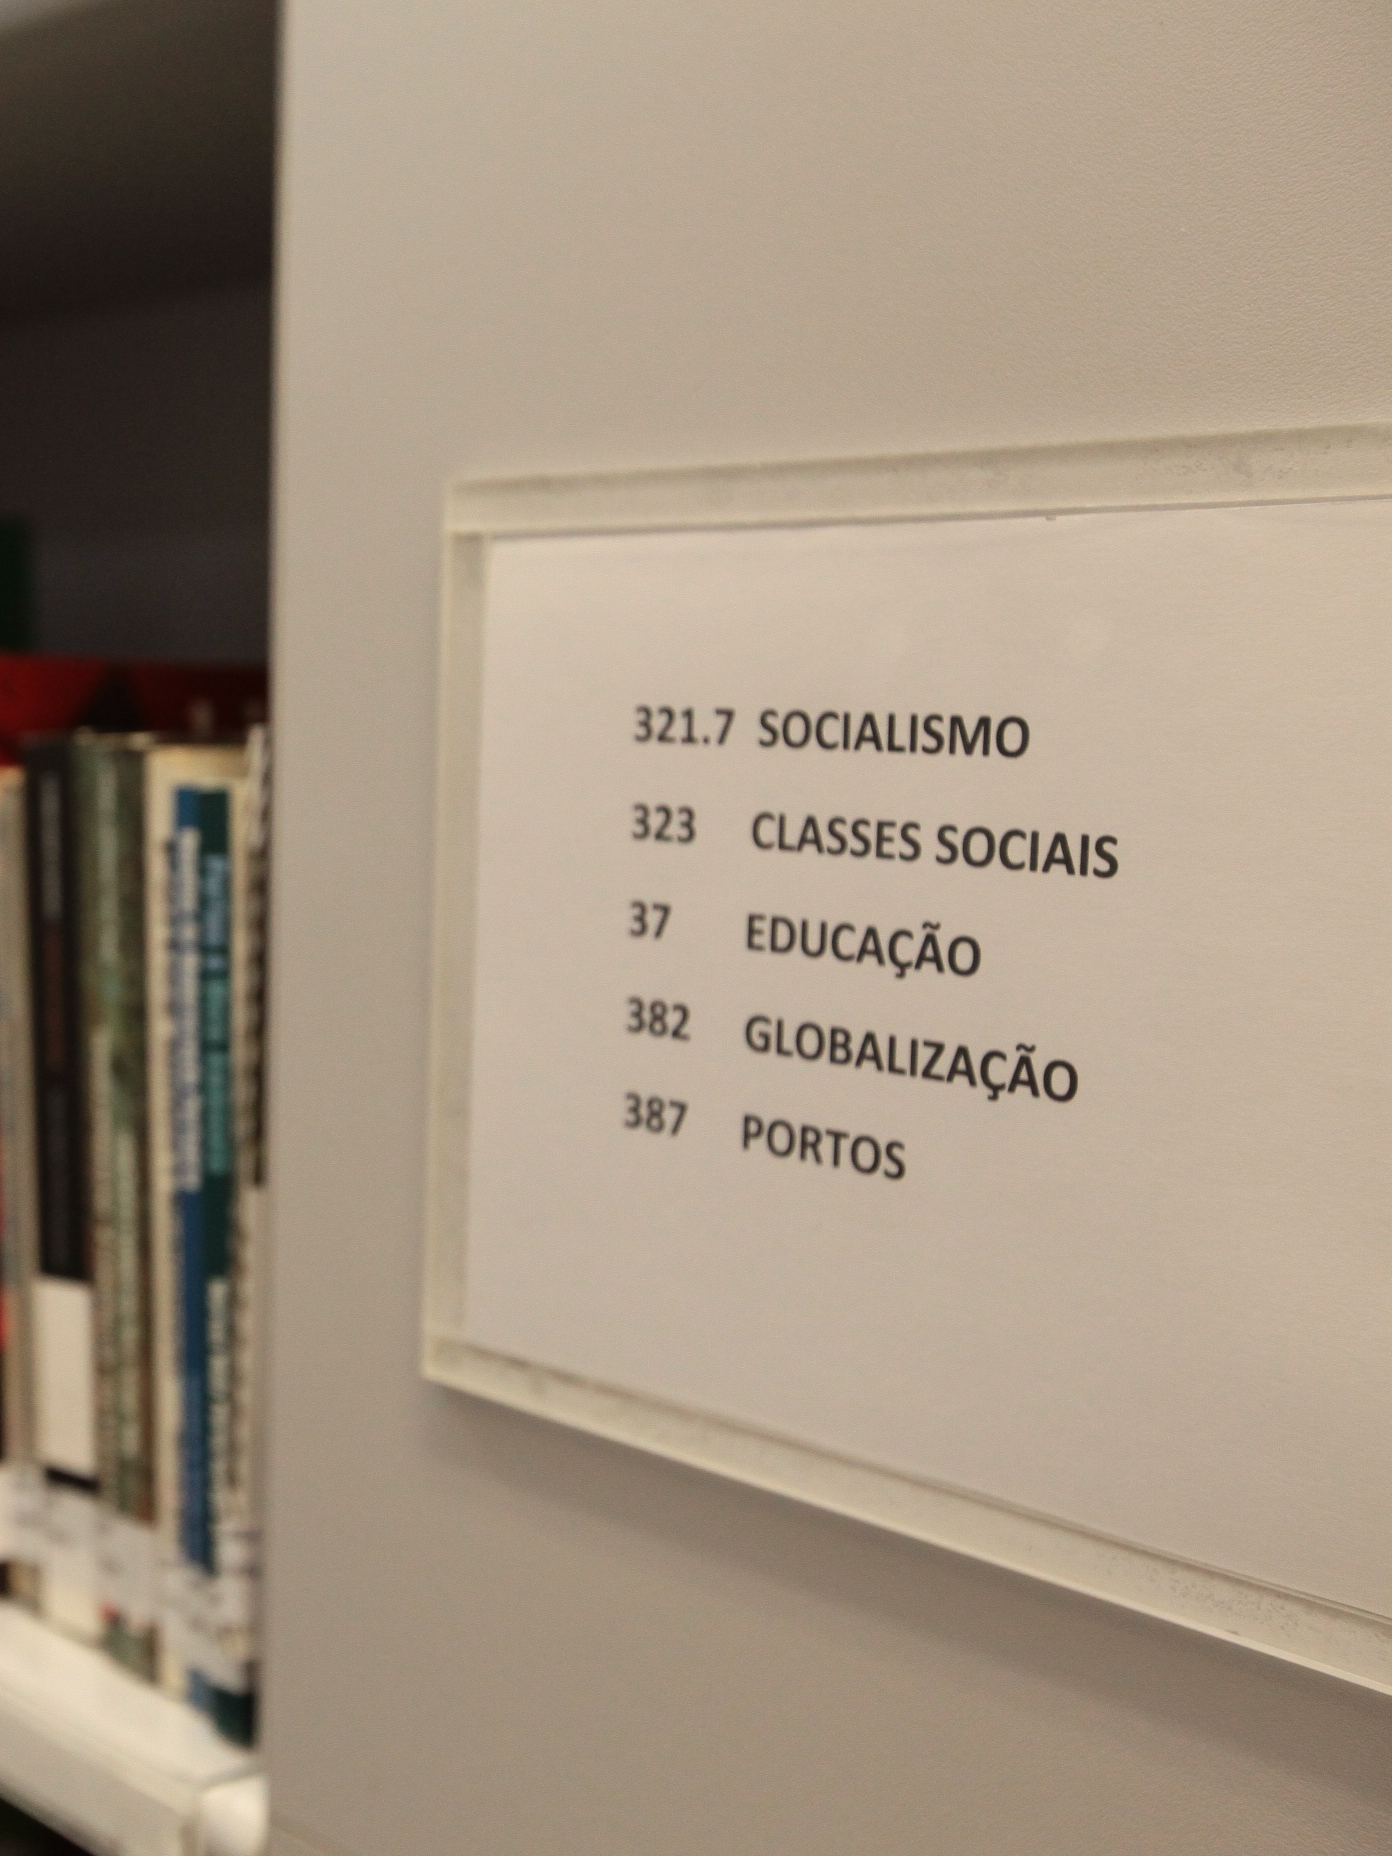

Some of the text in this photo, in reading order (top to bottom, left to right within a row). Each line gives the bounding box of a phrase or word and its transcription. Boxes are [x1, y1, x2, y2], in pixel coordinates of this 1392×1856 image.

[634, 705, 1030, 759] 321.7 SOCIALISMO
[632, 803, 1120, 879] 323 CLASSES SOCIAIS
[629, 901, 982, 980] 37 EDUCAÇÃO
[627, 996, 1080, 1104] 382 GLOBALIZAÇÃO
[624, 1092, 907, 1181] 387 PORTOS
